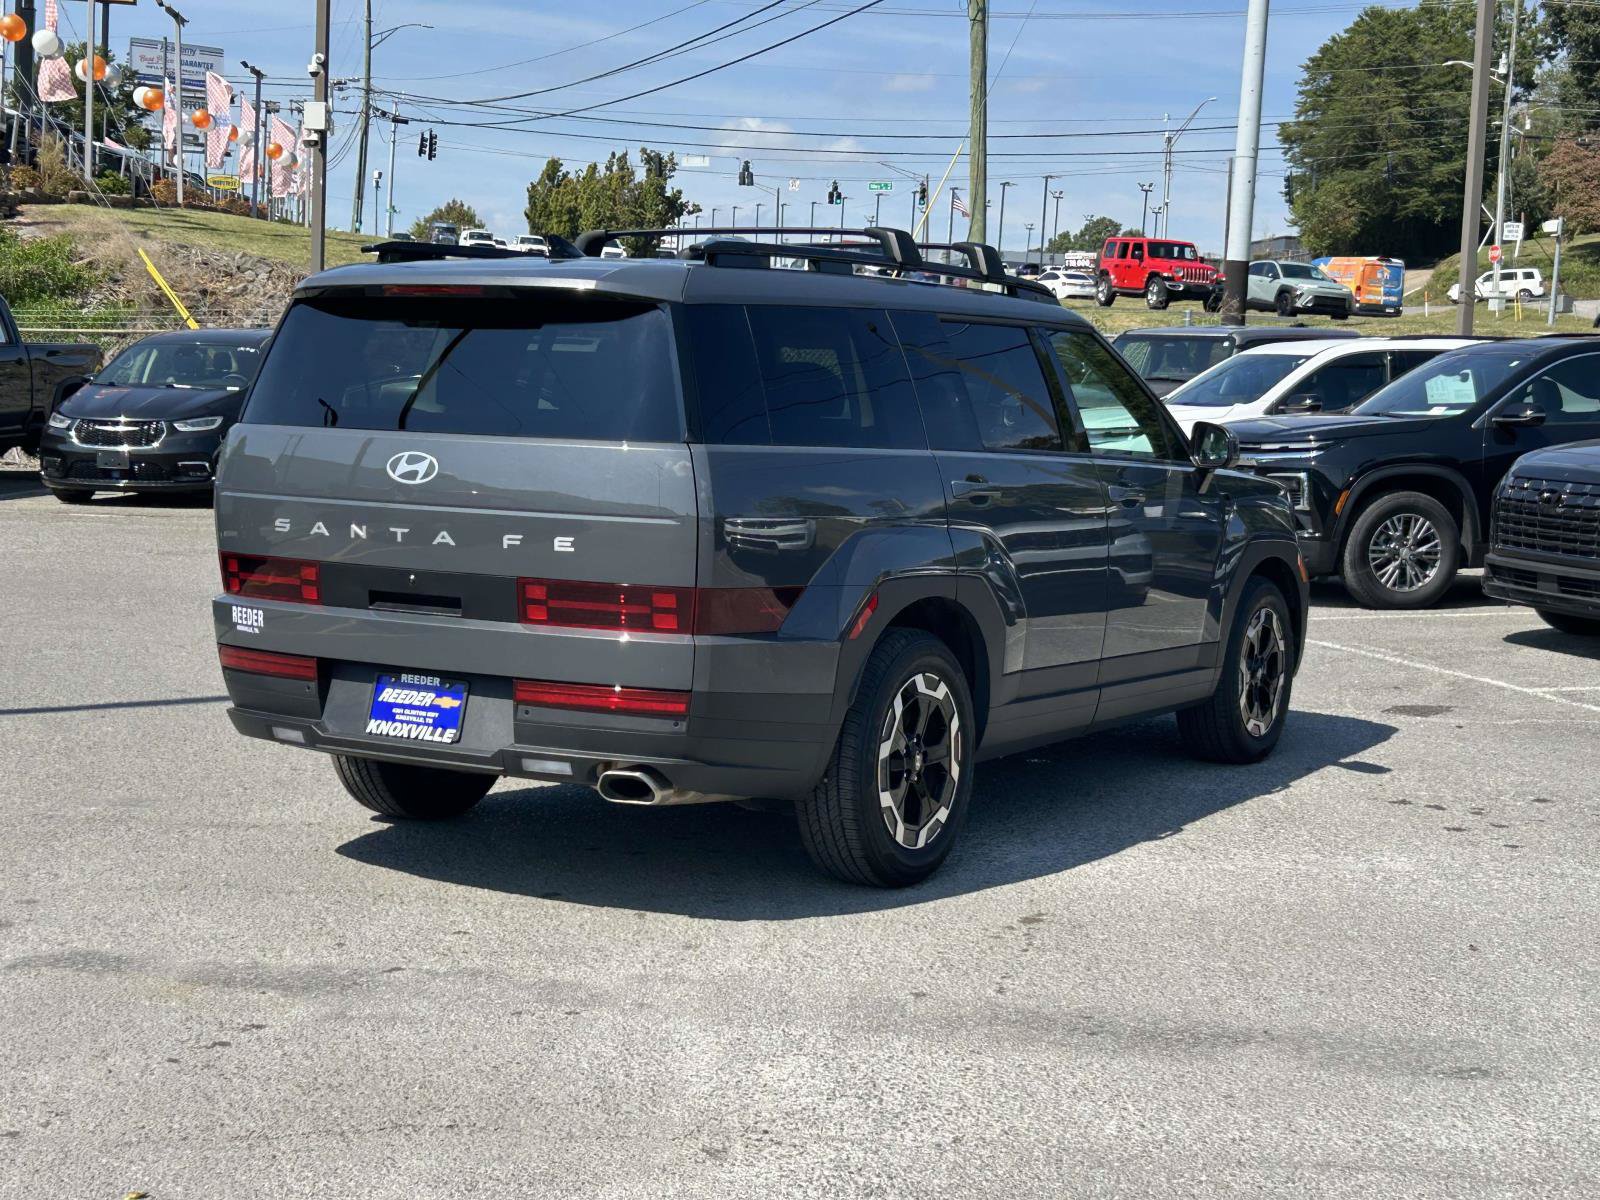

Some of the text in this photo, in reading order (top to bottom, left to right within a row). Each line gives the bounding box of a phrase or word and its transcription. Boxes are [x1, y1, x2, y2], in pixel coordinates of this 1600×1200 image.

[274, 518, 575, 552] SANTA FE
[231, 605, 264, 628] REEDER
[401, 674, 440, 686] REEDER
[378, 688, 436, 705] REEDER
[366, 719, 456, 743] KNOXVILLE
